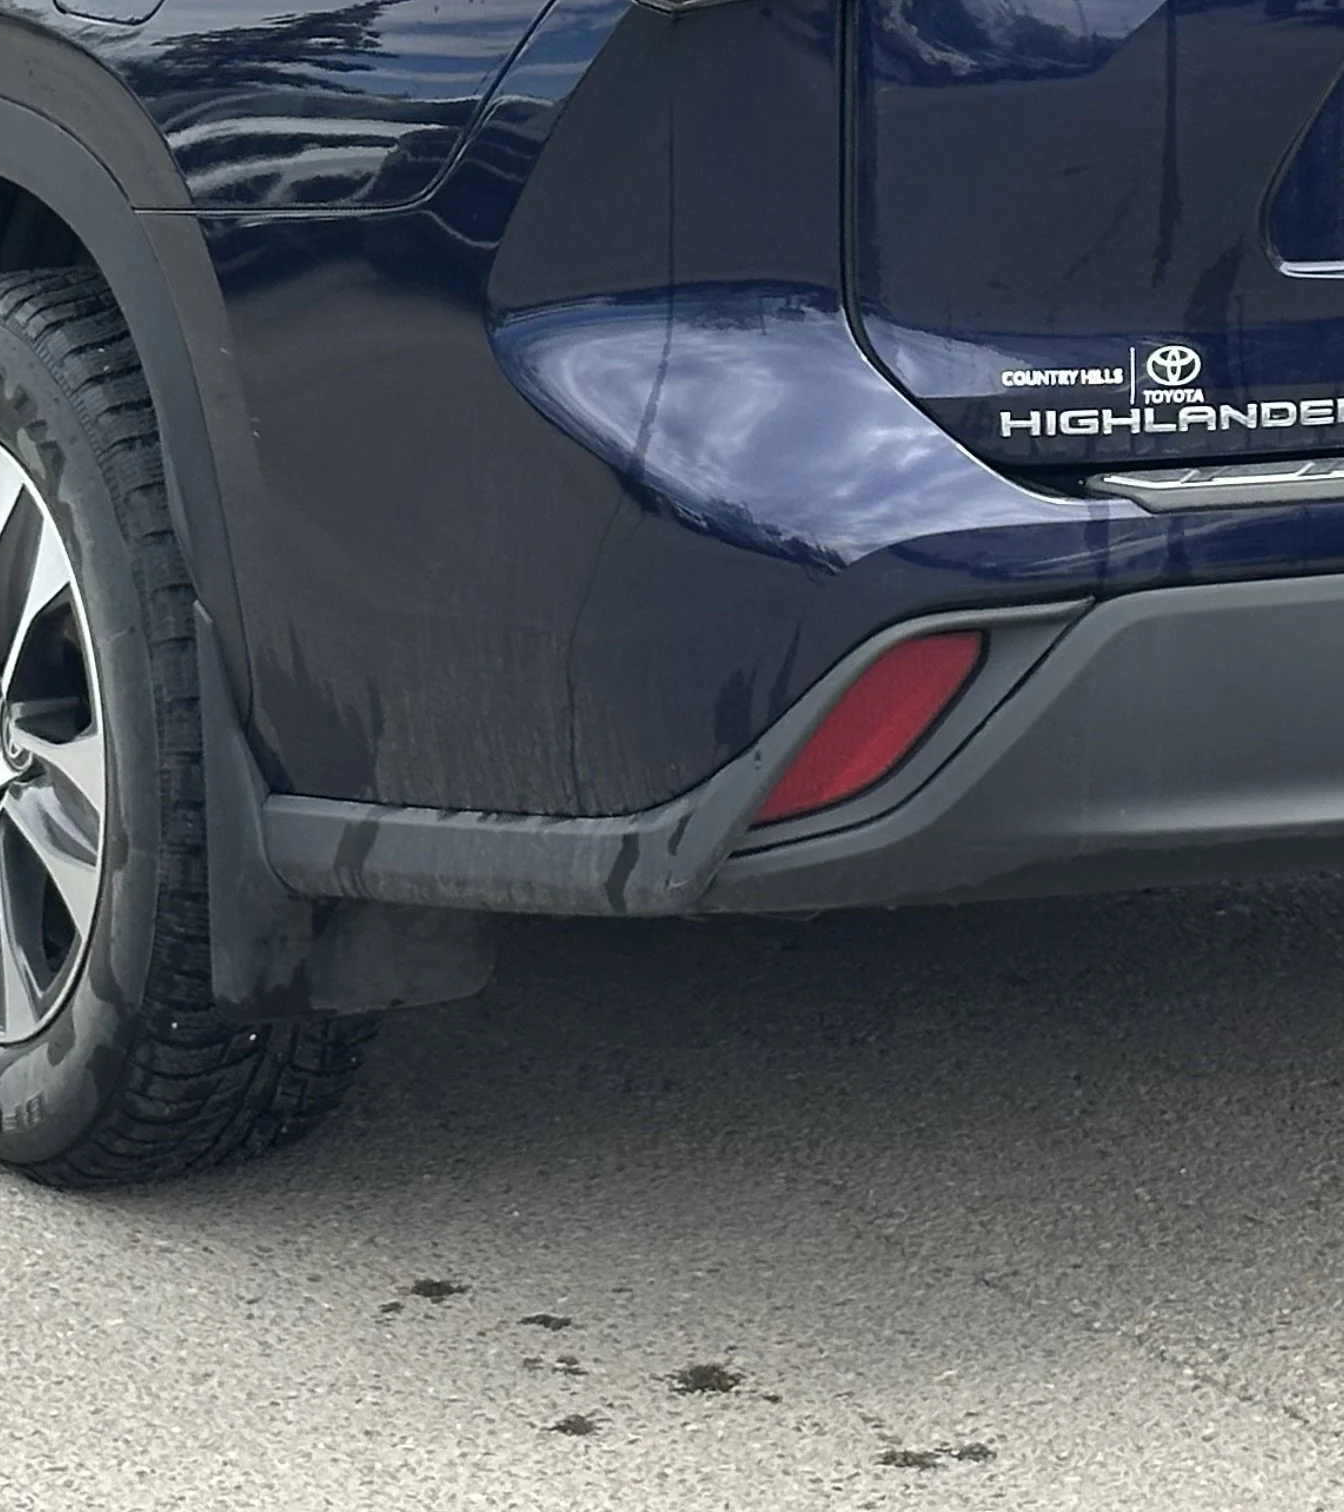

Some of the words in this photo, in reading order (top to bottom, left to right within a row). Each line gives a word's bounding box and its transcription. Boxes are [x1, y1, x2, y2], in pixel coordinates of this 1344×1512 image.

[1001, 369, 1080, 387] COUNTRY
[1080, 367, 1125, 385] HILLS
[1143, 389, 1206, 405] TOYOTA
